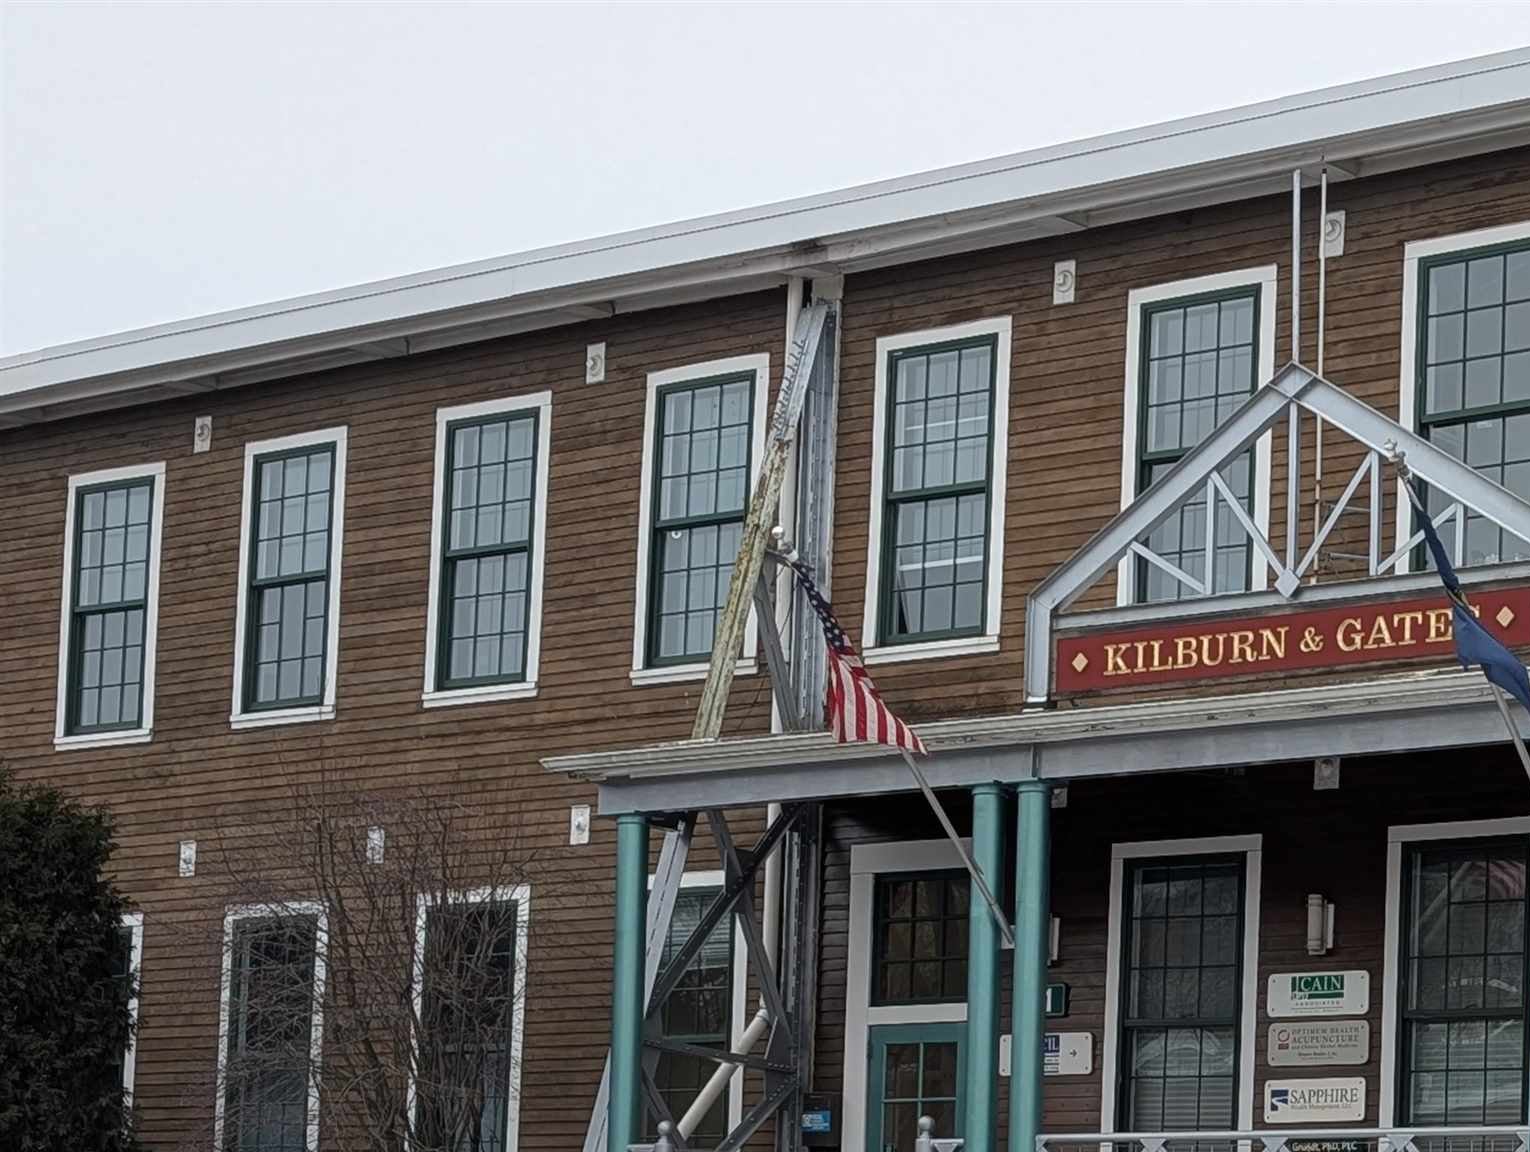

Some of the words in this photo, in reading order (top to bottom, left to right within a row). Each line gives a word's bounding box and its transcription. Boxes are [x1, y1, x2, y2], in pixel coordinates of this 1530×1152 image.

[1103, 627, 1288, 676] KILBURN
[1299, 625, 1324, 653] &
[1336, 605, 1480, 652] GATE
[1291, 1034, 1359, 1045] ACUPUNCTURE
[1290, 1087, 1360, 1104] SAPPHIRE
